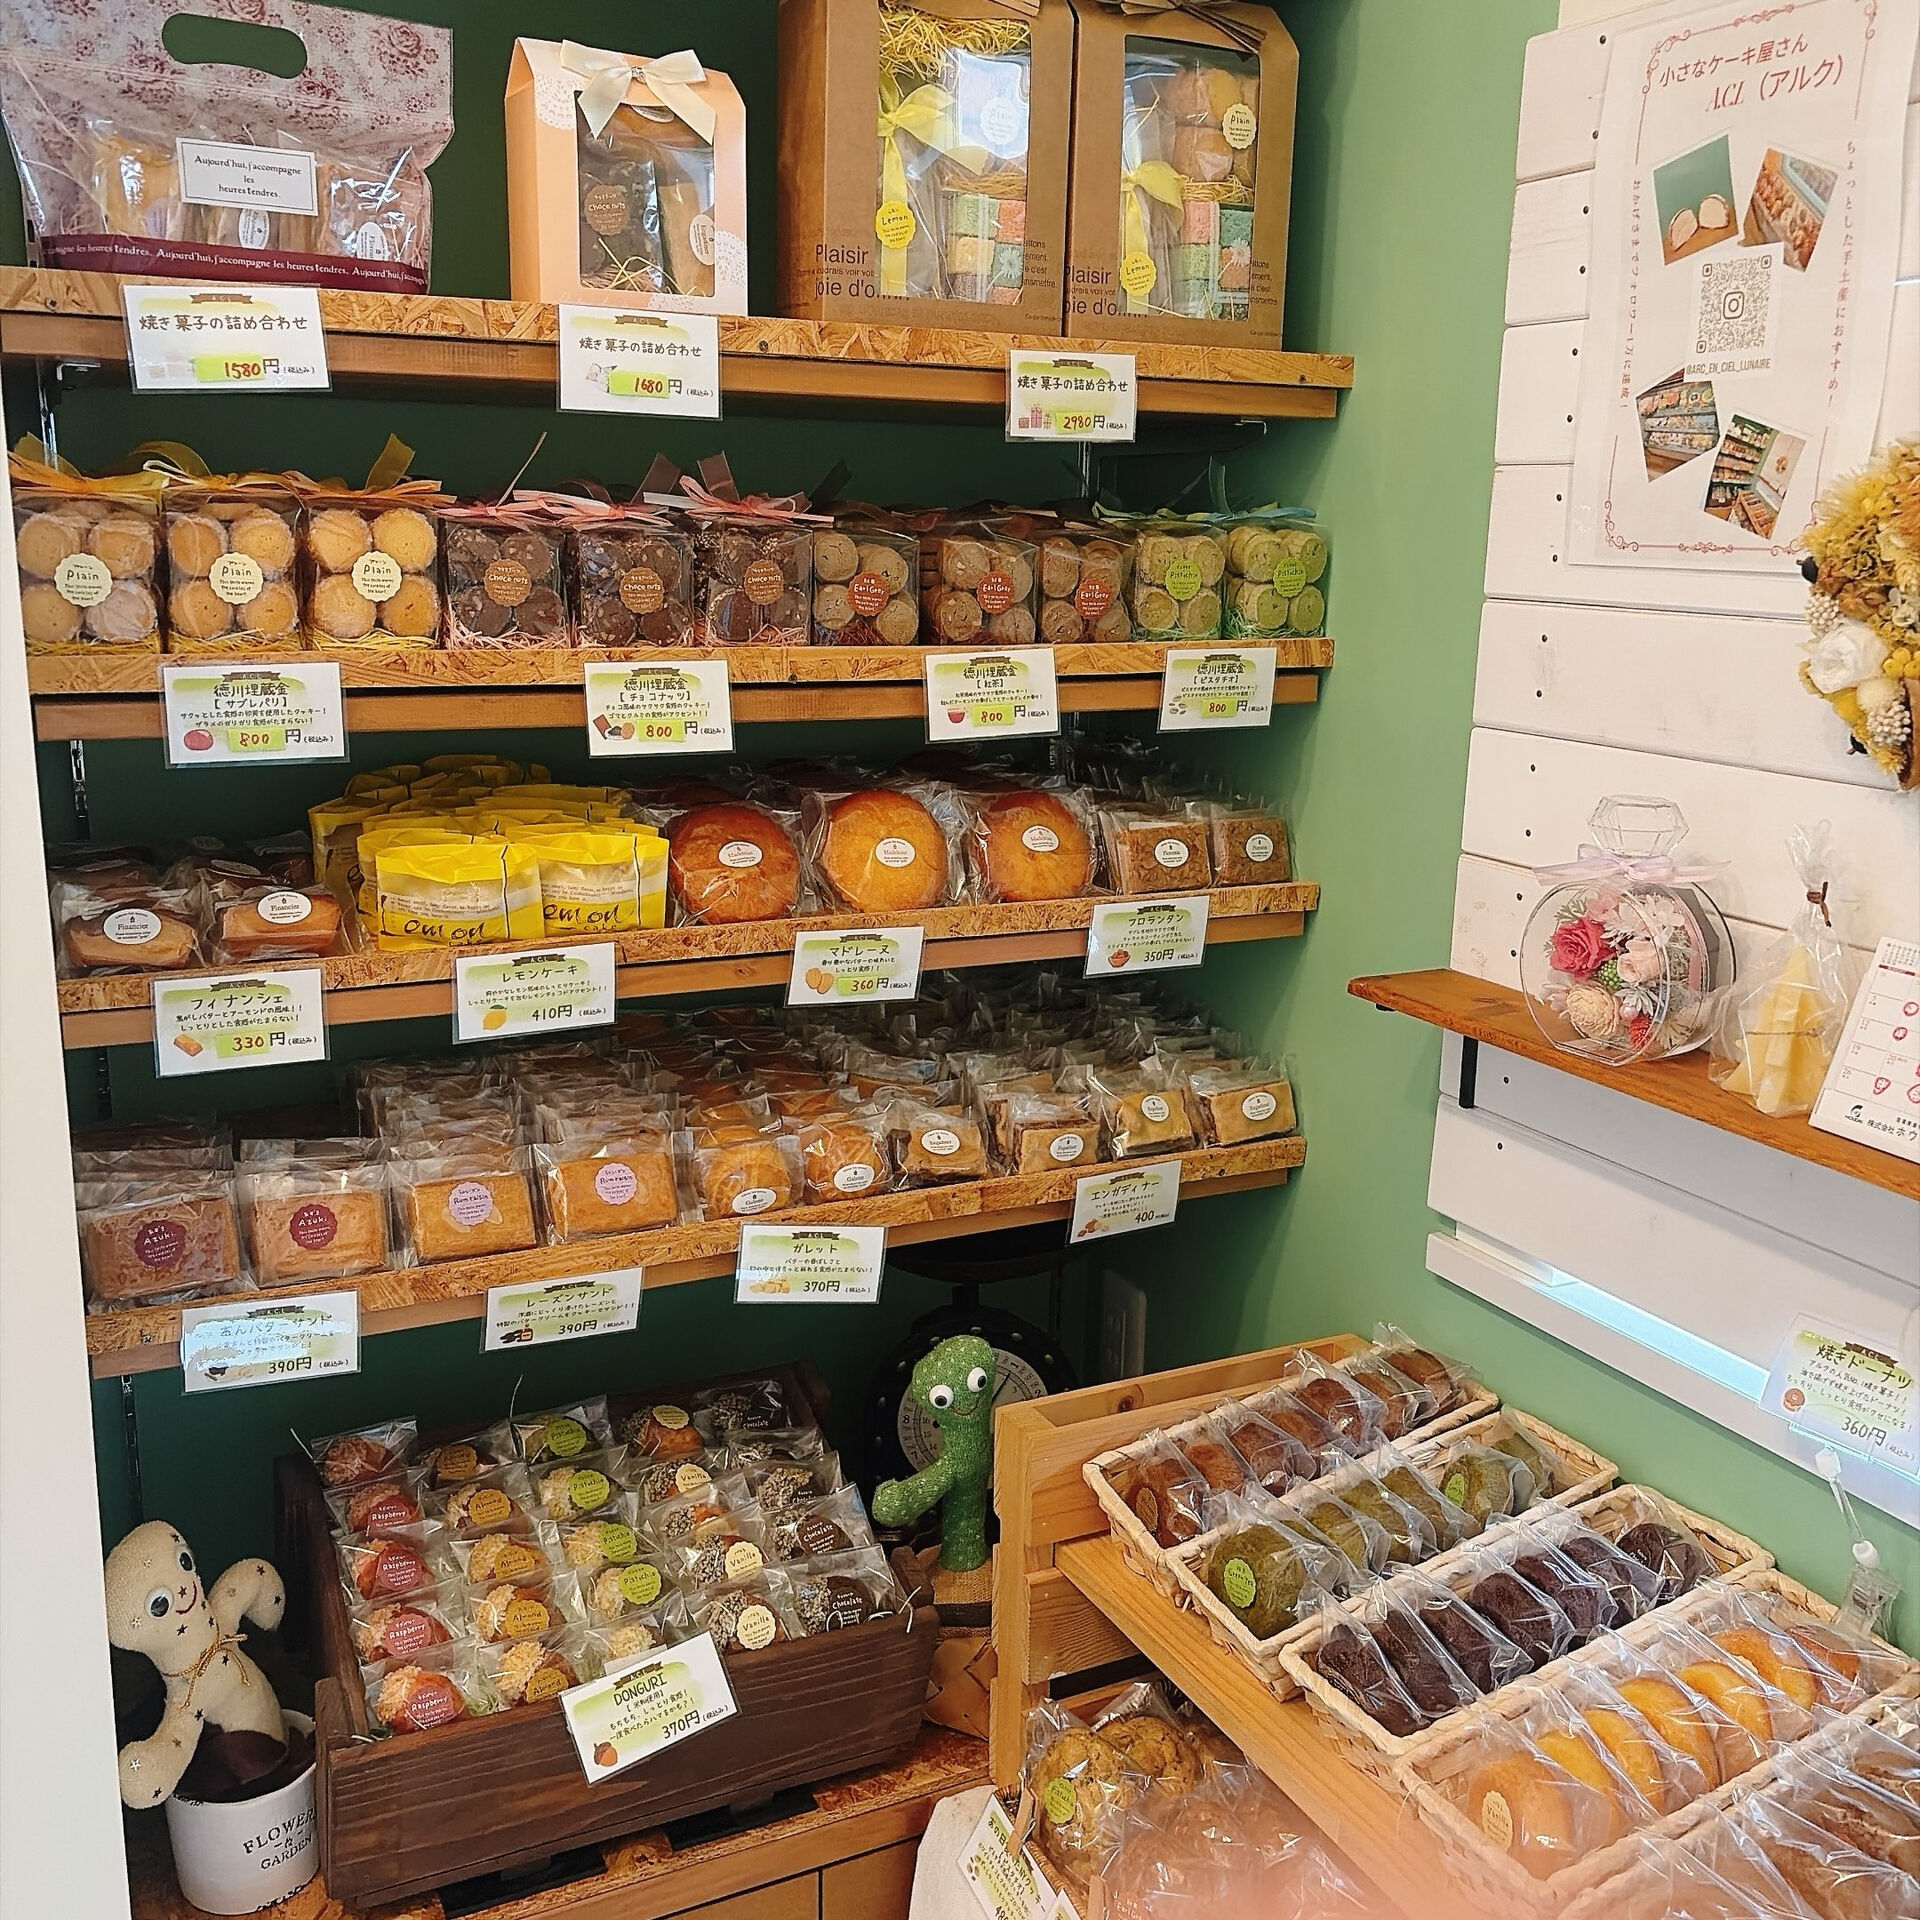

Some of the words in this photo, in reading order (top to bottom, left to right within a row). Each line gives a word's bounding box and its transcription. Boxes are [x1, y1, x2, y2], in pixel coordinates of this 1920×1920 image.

[1659, 32, 1808, 88] 小さなケーキ屋さん
[1230, 114, 1250, 126] Plain
[243, 175, 255, 184] les
[218, 183, 247, 195] heures
[881, 213, 909, 227] Lemon
[816, 244, 869, 265] Plaisir
[273, 259, 285, 269] les
[286, 260, 314, 271] heures
[315, 262, 349, 275] tendres.
[1125, 263, 1150, 276] Lemon
[815, 277, 843, 300] joie
[138, 314, 308, 332] 焼き菓子の詰め合わせ
[578, 336, 702, 357] 焼き菓子の詰め合わせ
[223, 357, 280, 379] 1580円
[1685, 357, 1771, 376] @ARC_EN_CIEL_LUNAIRE
[634, 376, 683, 395] 1680円
[1017, 375, 1129, 392] 焼き菓子の詰め合わせ
[1063, 415, 1106, 430] 2980円
[66, 569, 99, 581] Plain
[221, 565, 252, 577] Plain
[363, 564, 392, 575] Plain
[963, 665, 1018, 679] 徳川埋蔵金
[1196, 662, 1246, 675] 徳川埋蔵金
[213, 682, 290, 698] 徳川埋蔵金
[623, 677, 688, 691] 徳川埋蔵金
[976, 679, 1004, 689] 【紅茶】
[214, 696, 288, 710] 【サブレパリ】
[619, 691, 691, 702] 【チョコナッツ】
[980, 704, 1026, 723] 800円
[1208, 700, 1248, 713] 800円
[645, 720, 698, 738] 800円
[239, 728, 301, 747] 800円
[544, 903, 622, 924] emon
[1128, 914, 1184, 927] フロランタン
[829, 944, 891, 957] マドレーヌ
[1143, 948, 1175, 962] 350円
[502, 965, 579, 983] レモンケーキ
[851, 977, 889, 992] 360円
[190, 993, 284, 1011] フィナンシェ
[531, 1004, 573, 1022] 410円
[232, 1031, 286, 1052] 330円
[1091, 1181, 1160, 1201] エンガディナー
[298, 1215, 328, 1227] Azuki
[1134, 1210, 1155, 1224] 400
[143, 1230, 176, 1245] Azuki
[793, 1242, 838, 1254] ガレット
[803, 1280, 841, 1293] 370円
[526, 1287, 614, 1308] レーズンサンド
[220, 1314, 333, 1337] あんバターサンド
[558, 1319, 598, 1335] 390円
[268, 1356, 312, 1374] 390円
[1815, 1344, 1912, 1390] 焼きドーナツ
[902, 1414, 911, 1424] 8
[1841, 1416, 1887, 1447] 360円
[679, 1472, 707, 1482] Vanilla
[371, 1511, 407, 1521] Raspberry
[802, 1521, 835, 1542] Chocolate
[382, 1560, 416, 1572] Raspberry
[729, 1551, 757, 1568] Vanilla
[832, 1596, 863, 1610] Chocolate
[512, 1610, 543, 1622] Almond
[742, 1615, 770, 1632] Vanilla
[389, 1623, 426, 1640] Raspberry
[613, 1671, 668, 1707] DONGURI
[411, 1695, 448, 1712] Raspberry
[661, 1709, 701, 1740] 370円
[260, 1833, 313, 1870] GARDEN
